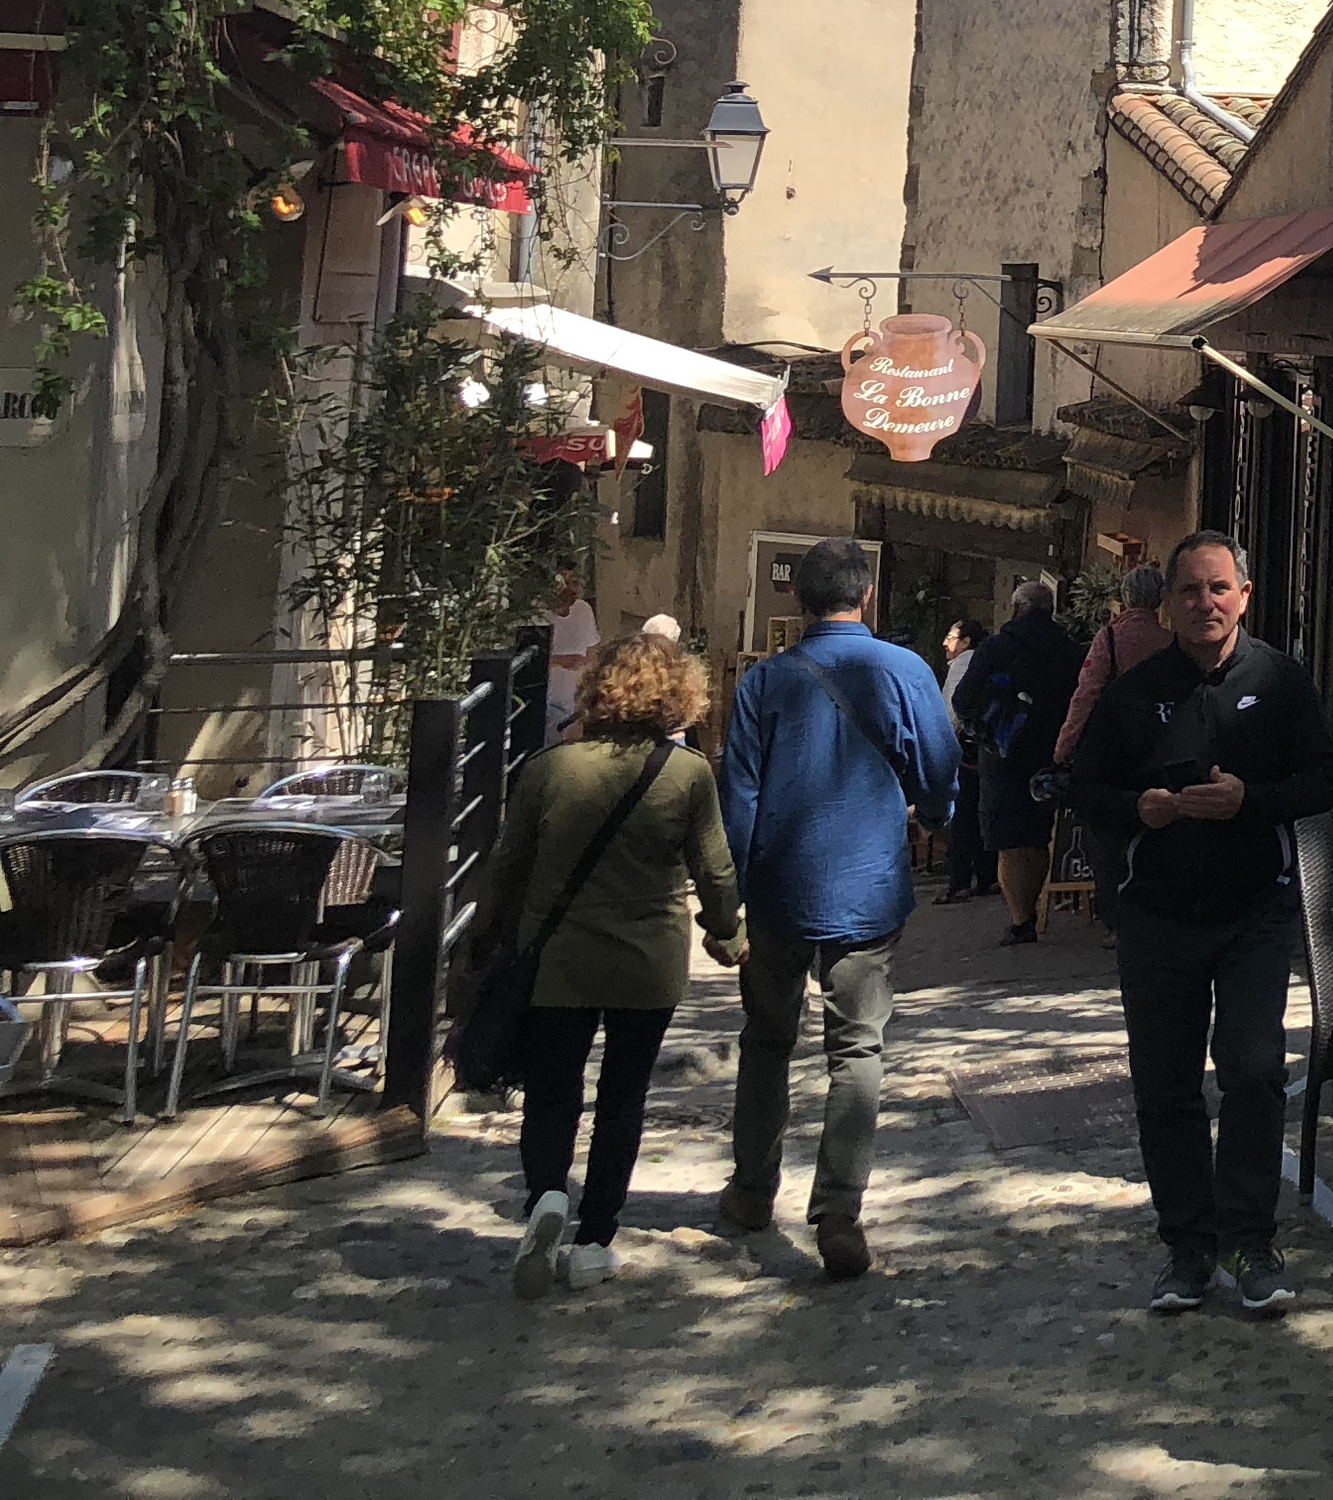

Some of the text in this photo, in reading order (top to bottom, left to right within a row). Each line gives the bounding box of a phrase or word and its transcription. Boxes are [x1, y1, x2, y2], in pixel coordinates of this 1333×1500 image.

[869, 356, 955, 379] Restaurant
[853, 380, 971, 408] La Bonne
[863, 407, 955, 434] Demeure
[771, 562, 792, 582] BAR
